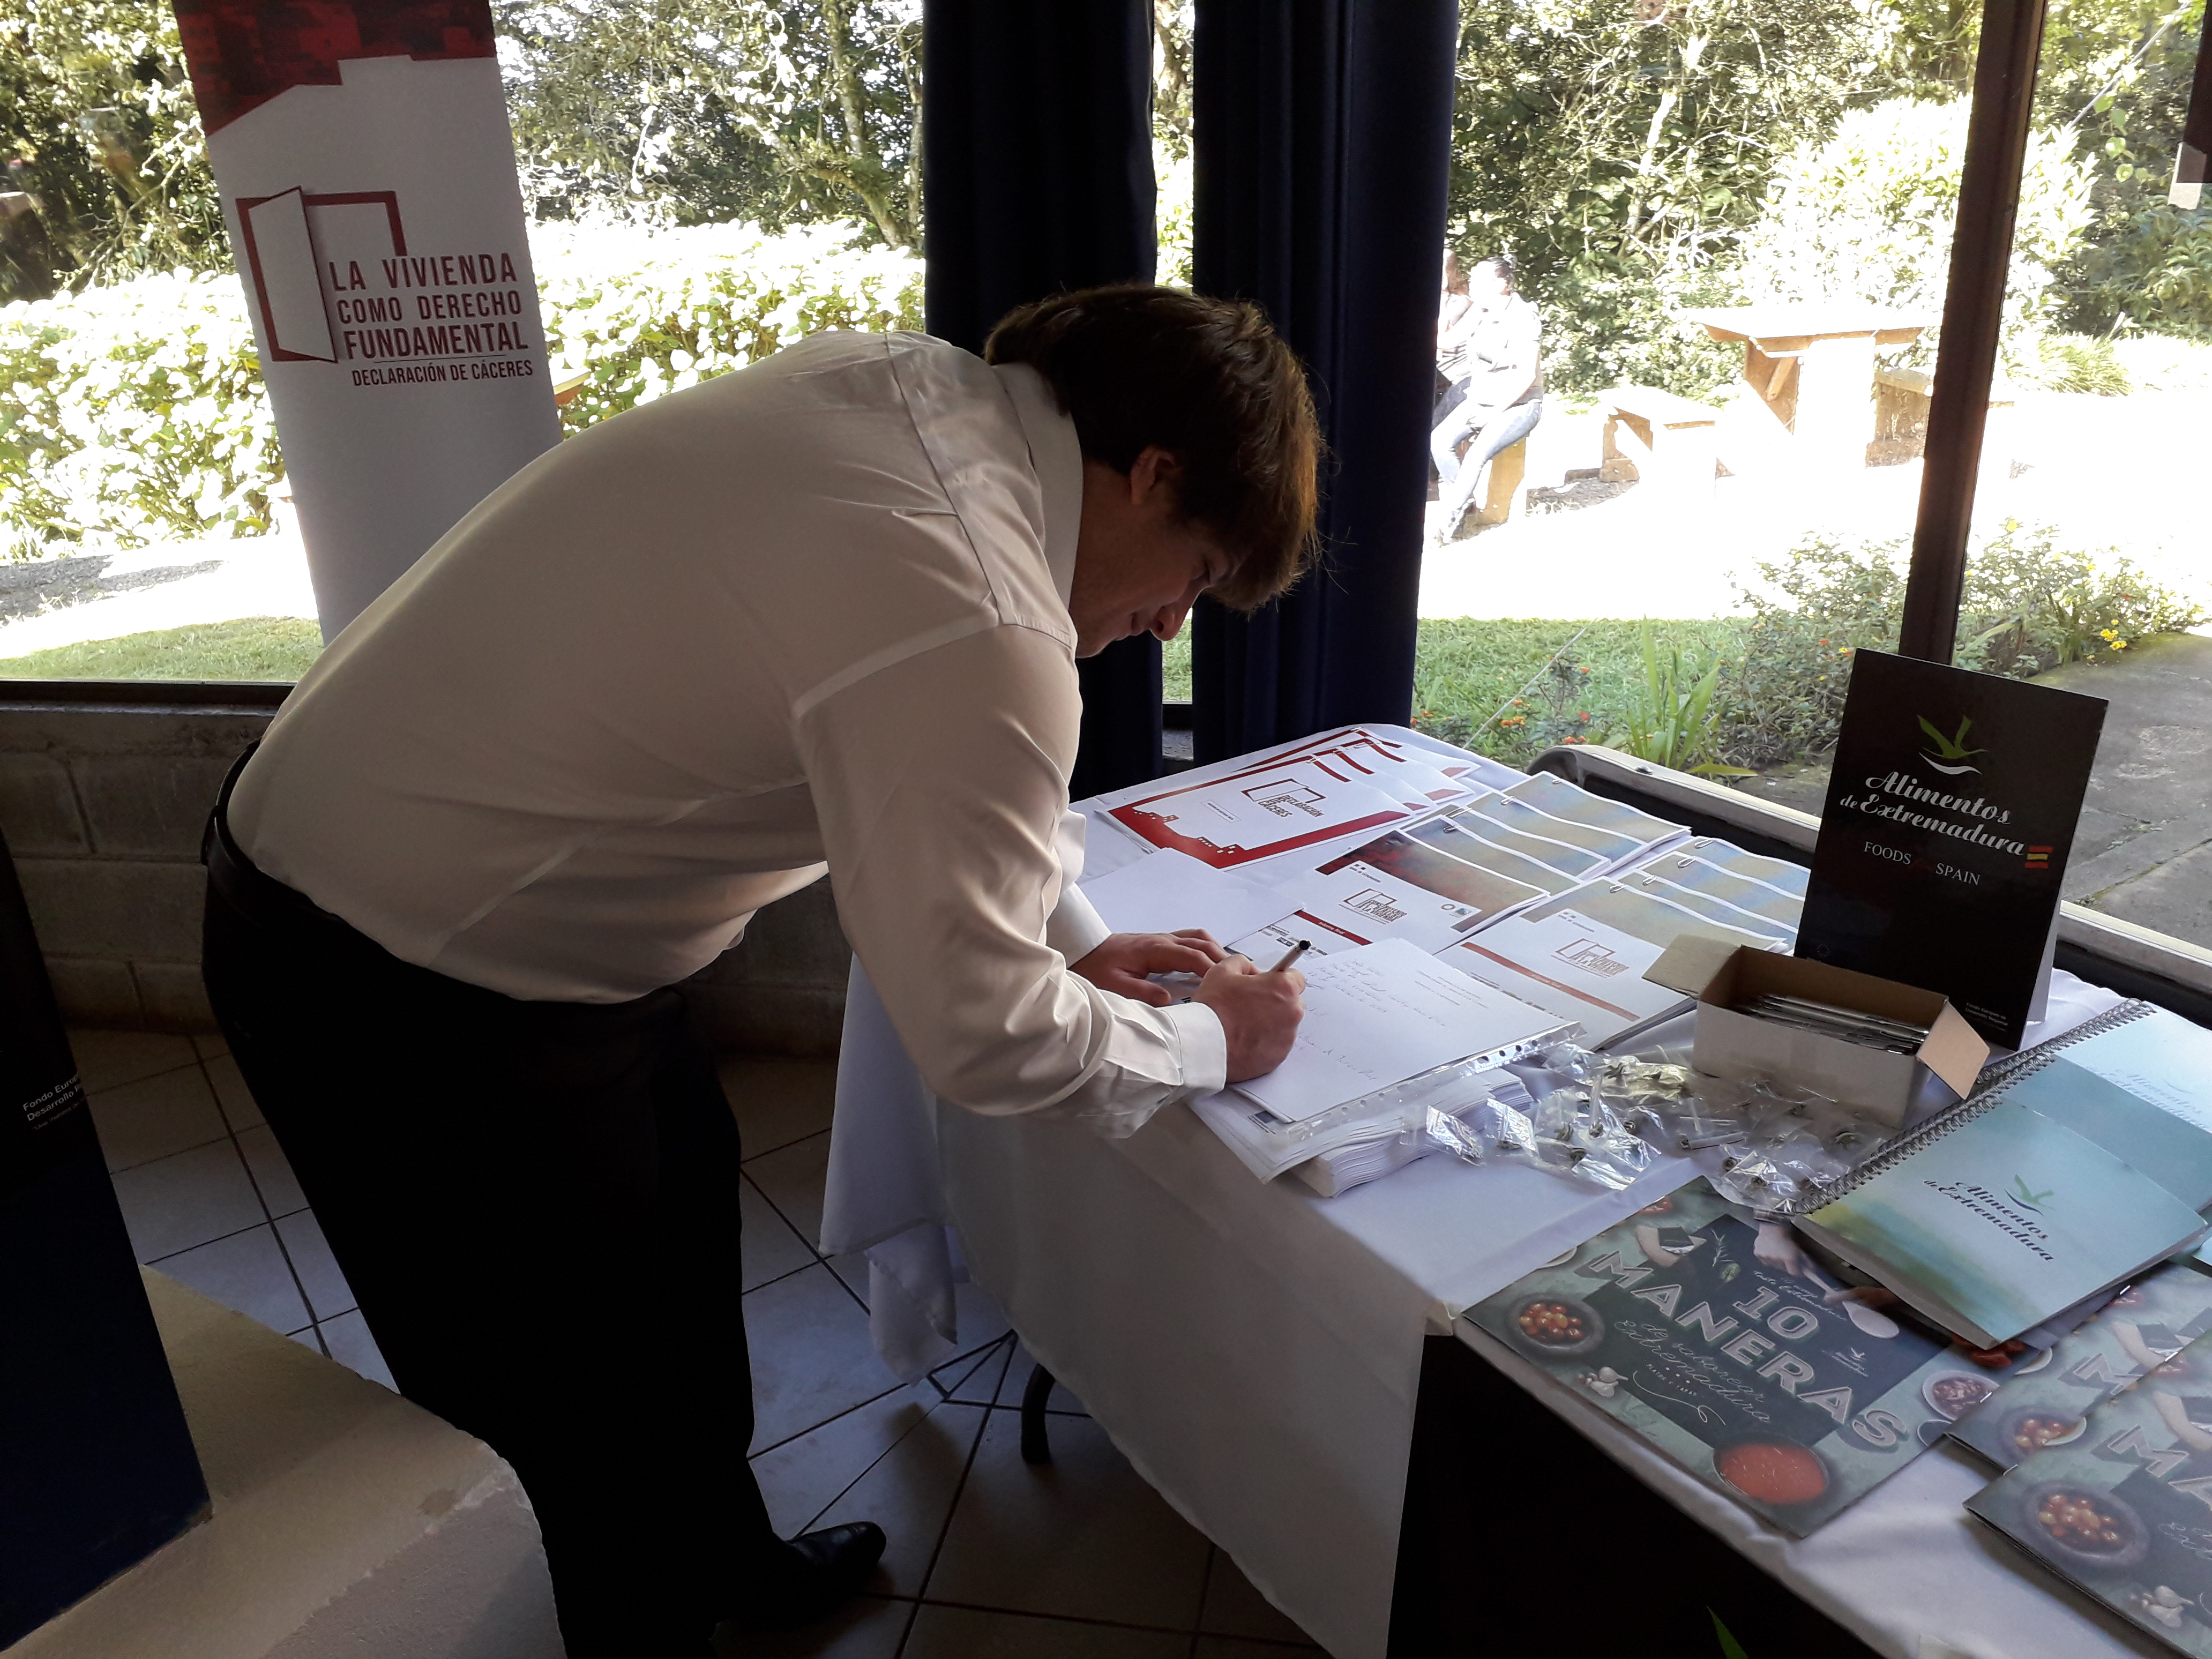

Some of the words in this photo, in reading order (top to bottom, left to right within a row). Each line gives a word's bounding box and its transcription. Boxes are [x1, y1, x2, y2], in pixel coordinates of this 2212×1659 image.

[328, 260, 366, 292] LA
[382, 252, 518, 289] VIVIENDA
[336, 296, 403, 324] COMO
[416, 289, 522, 320] DERECHO
[343, 321, 528, 359] FUNDAMENTAL
[352, 362, 447, 386] DECLARACIÓN
[450, 363, 468, 380] DE
[471, 359, 533, 380] CÁCERES
[1865, 771, 2011, 825] Alimentos
[1840, 795, 1858, 809] de
[1860, 794, 2026, 856] Extremadura
[1864, 841, 1911, 865] FOODS
[1935, 863, 1981, 886] SPAIN
[23, 1091, 54, 1112] Fondo
[27, 1090, 74, 1122] Desarrollo
[1938, 1186, 2054, 1262] Extremadura
[1955, 1181, 2049, 1240] Alimentos
[1733, 1286, 1819, 1339] 10
[1590, 1250, 1905, 1446] MANERAS
[1641, 1324, 1669, 1338] de
[1672, 1343, 1764, 1402] saborear
